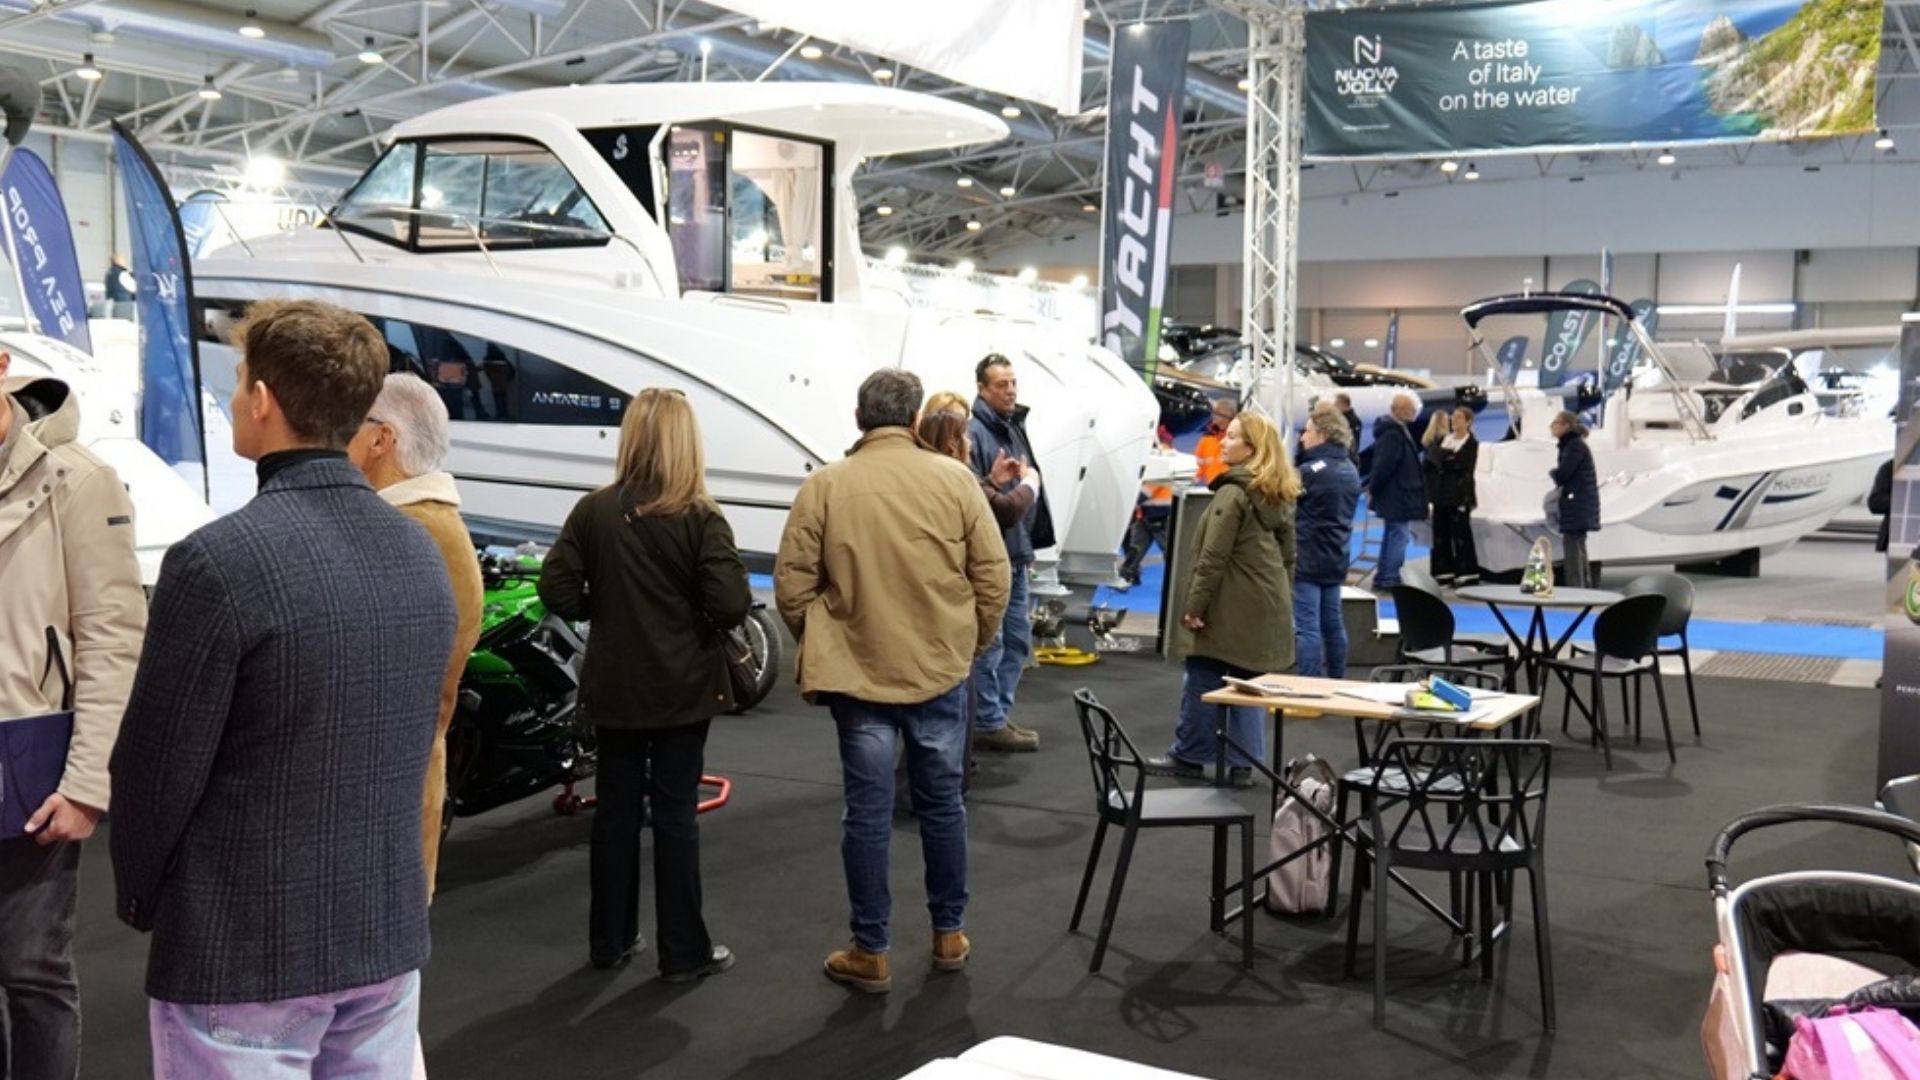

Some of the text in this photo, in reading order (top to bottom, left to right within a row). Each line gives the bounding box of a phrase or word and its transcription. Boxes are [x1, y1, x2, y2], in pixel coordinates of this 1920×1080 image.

[1451, 38, 1529, 61] A taste
[1335, 66, 1399, 82] NUOVA
[1468, 60, 1542, 85] of Italy
[1337, 79, 1398, 95] JOLLY
[1439, 85, 1582, 111] on the water
[1544, 308, 1584, 372] COAST
[532, 391, 621, 410] ANTARES 9
